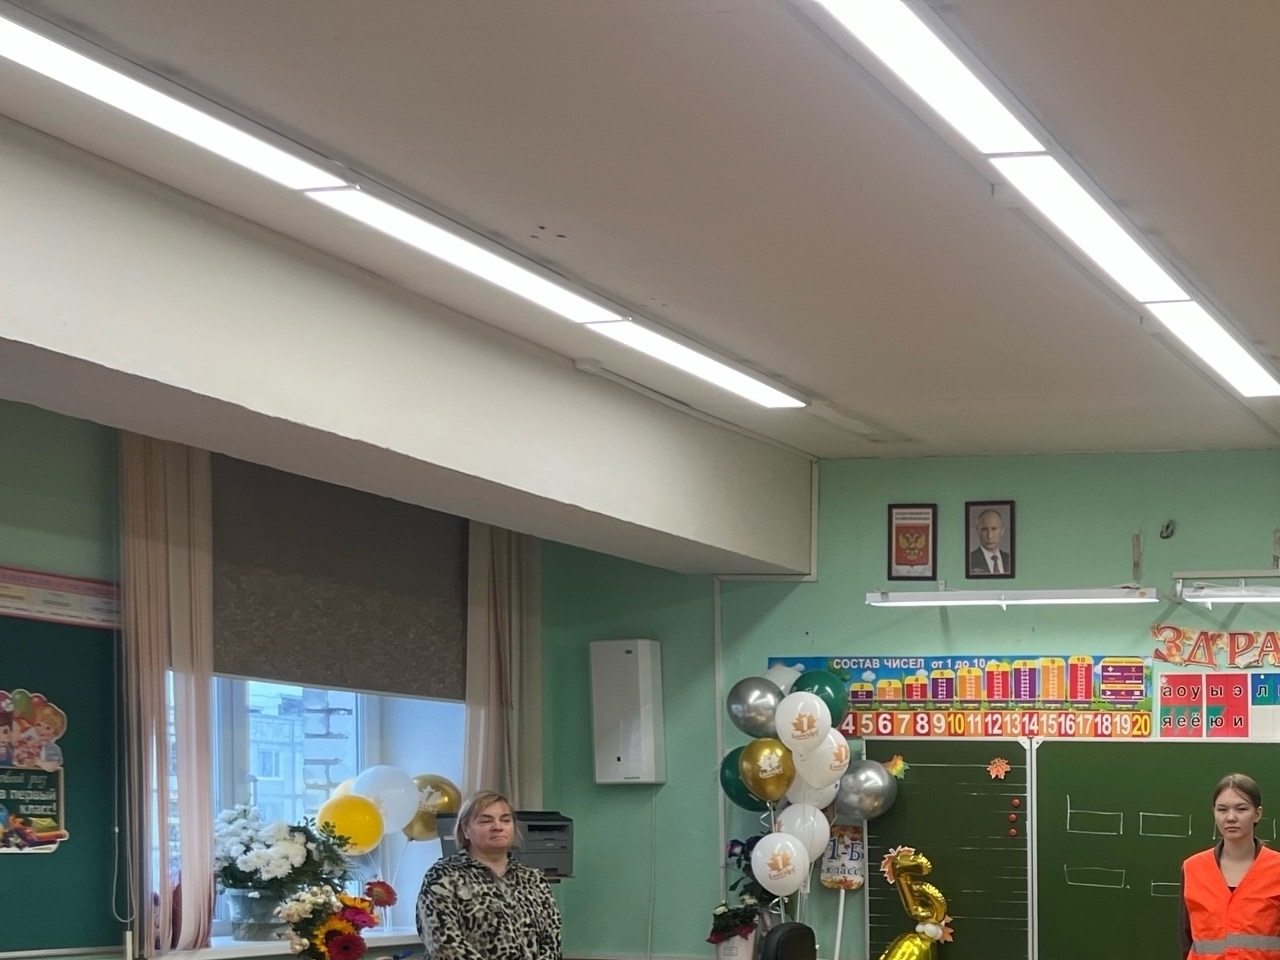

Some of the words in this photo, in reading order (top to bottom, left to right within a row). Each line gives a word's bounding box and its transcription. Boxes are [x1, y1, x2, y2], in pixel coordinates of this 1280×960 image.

[833, 658, 880, 669] СОСТАВ
[884, 658, 924, 669] ЧИСЕЛ
[931, 660, 943, 669] от
[946, 658, 951, 668] 1
[955, 660, 969, 670] до
[973, 658, 985, 668] 10
[842, 713, 855, 735] 4
[861, 713, 874, 735] 5
[878, 713, 892, 735] 6
[897, 713, 910, 735] 7
[916, 713, 929, 735] 8
[933, 713, 946, 735] 9
[948, 713, 965, 735] 10
[967, 713, 981, 735] 11
[985, 713, 1002, 735] 12
[1004, 713, 1020, 735] 13
[1022, 713, 1038, 735] 14
[1041, 713, 1057, 735] 15
[1059, 713, 1075, 735] 16
[1077, 713, 1093, 735] 17
[1095, 713, 1112, 735] 18
[1114, 713, 1131, 735] 19
[1132, 713, 1150, 735] 20
[10, 788, 56, 802] первый
[20, 802, 57, 815] класс!
[828, 838, 862, 861] 1-Б
[826, 865, 860, 876] класс
